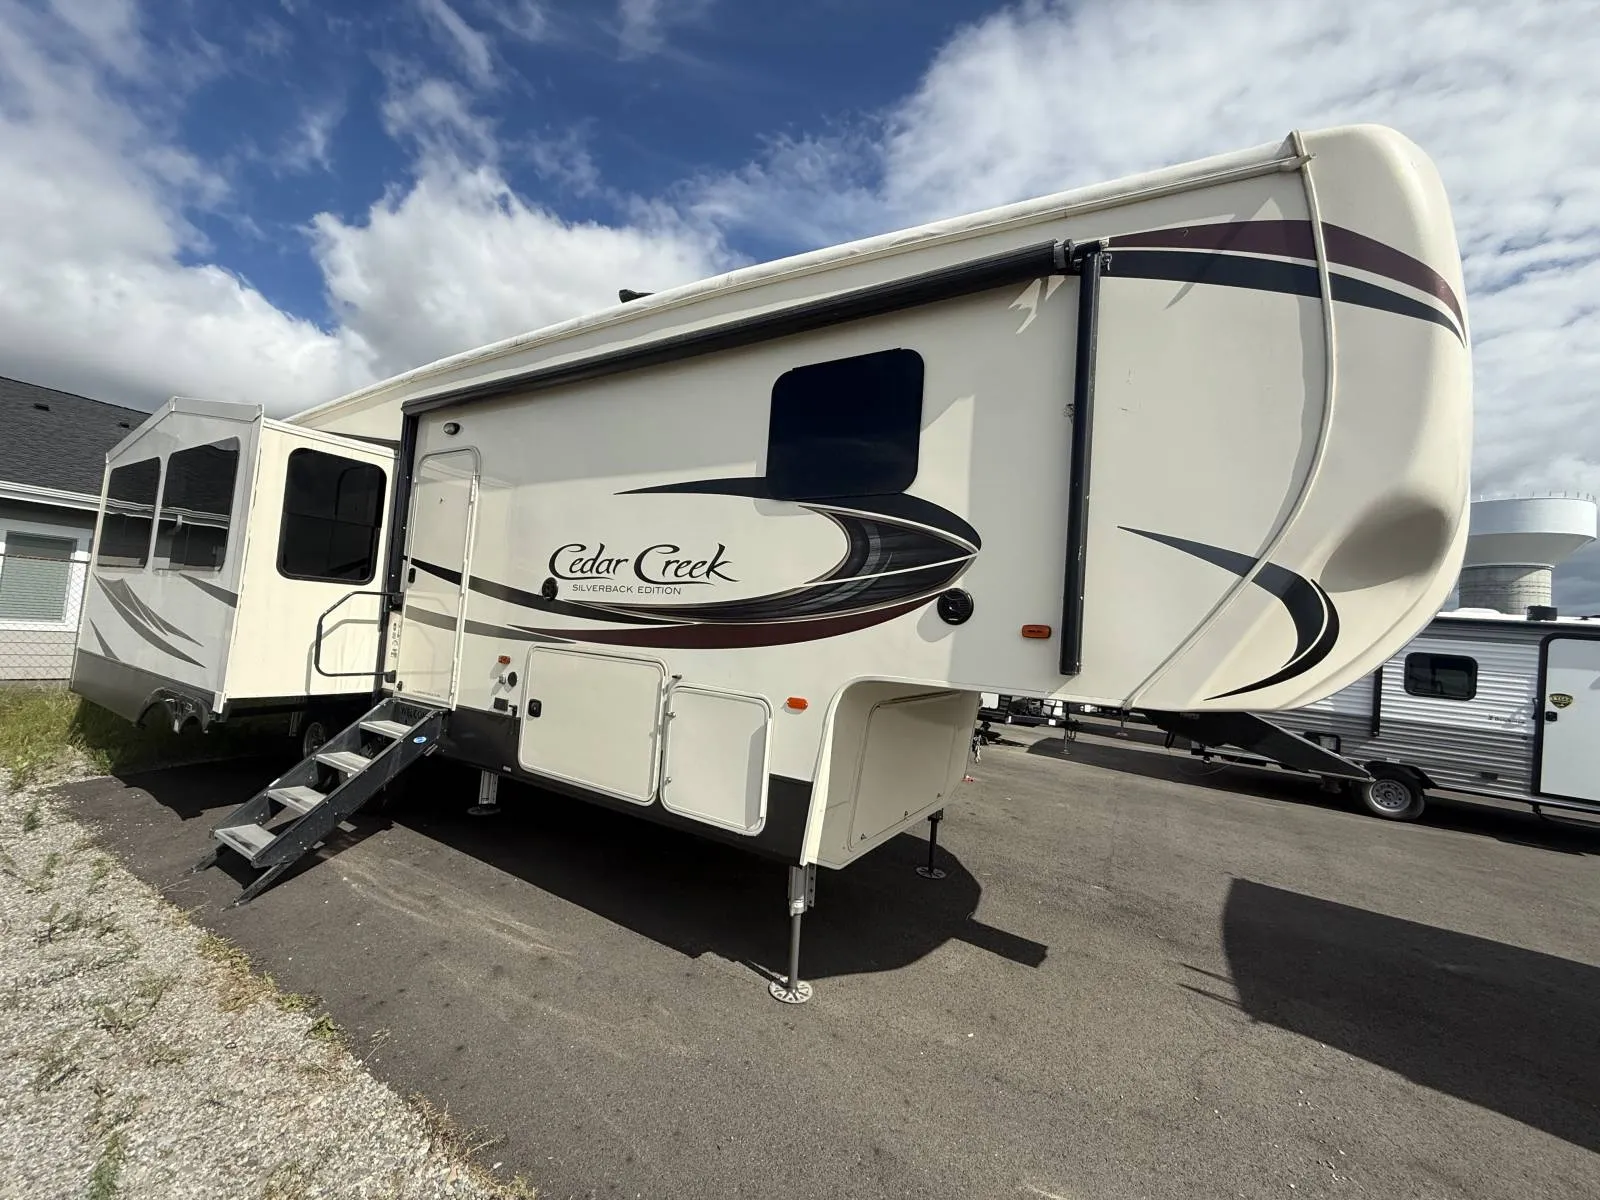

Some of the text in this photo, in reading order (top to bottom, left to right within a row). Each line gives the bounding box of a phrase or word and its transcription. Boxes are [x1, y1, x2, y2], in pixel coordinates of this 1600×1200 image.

[548, 542, 741, 586] Cedar Creek
[572, 584, 682, 595] SILVERBACK EDITION
